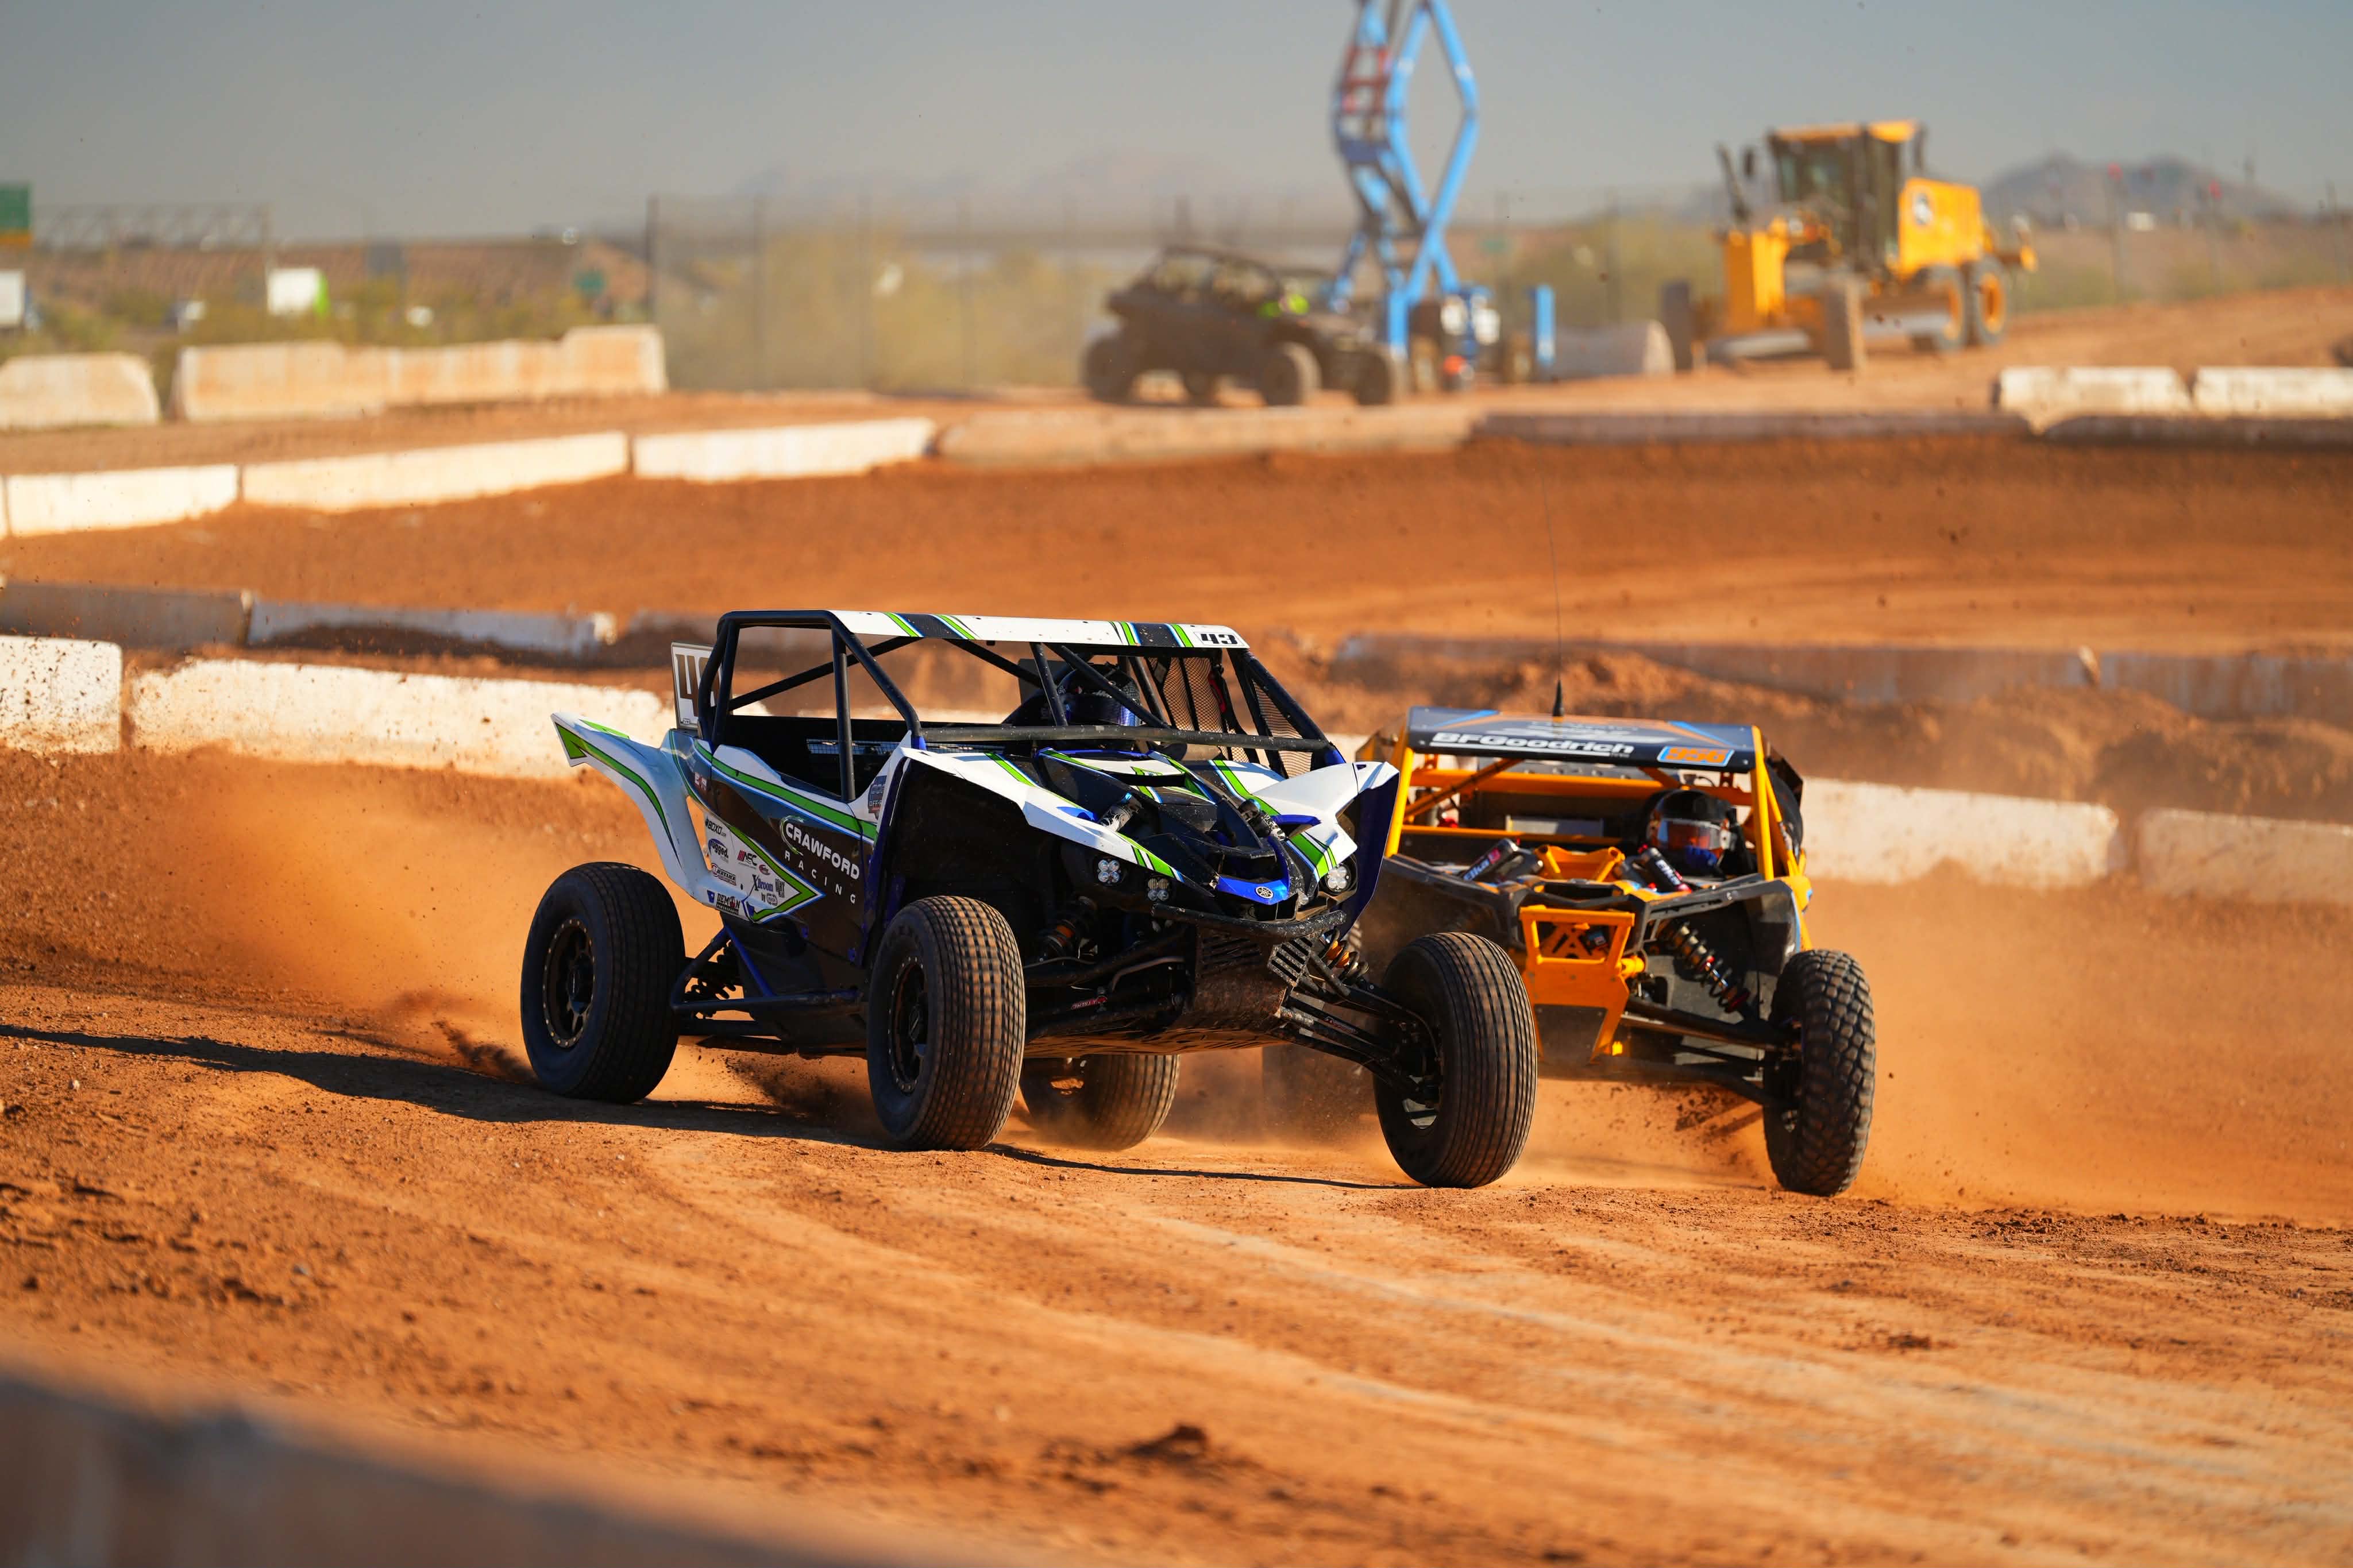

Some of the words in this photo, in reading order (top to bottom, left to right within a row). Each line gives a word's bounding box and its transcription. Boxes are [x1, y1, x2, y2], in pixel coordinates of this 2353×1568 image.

[1200, 634, 1238, 644] 43
[1432, 732, 1634, 754] BFGoodrich
[785, 822, 860, 880] CRAWFORD
[785, 850, 856, 904] RACING
